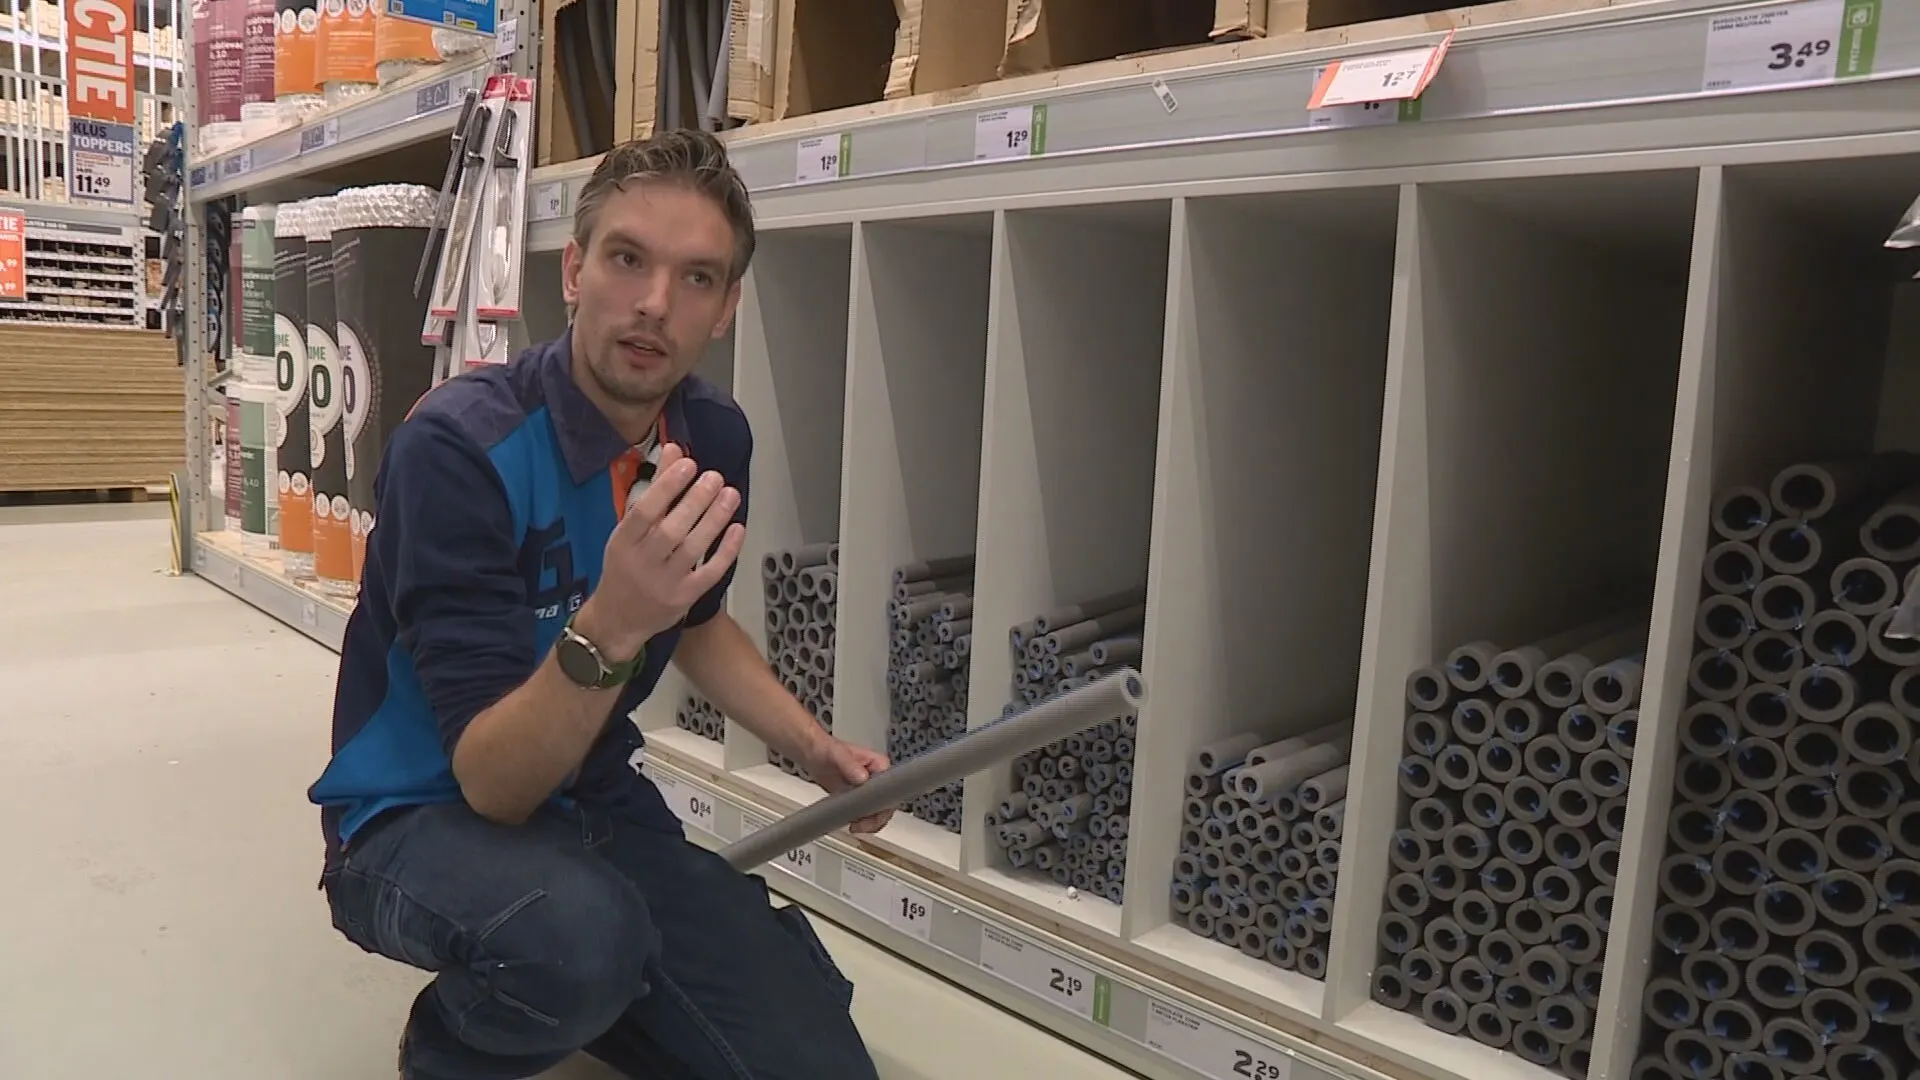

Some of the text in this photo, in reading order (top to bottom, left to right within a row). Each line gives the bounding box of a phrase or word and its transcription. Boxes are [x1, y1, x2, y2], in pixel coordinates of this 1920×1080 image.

[1767, 39, 1831, 70] 3.49
[1381, 70, 1417, 87] 1.27
[73, 122, 107, 138] KLUS
[1007, 130, 1028, 148] 1.29
[72, 134, 133, 154] TOPPERS
[820, 155, 837, 171] 1.29
[76, 174, 111, 194] 11.49
[900, 896, 926, 921] 1.69
[1049, 967, 1083, 997] 2.19
[1232, 1049, 1280, 1080] 2.29
